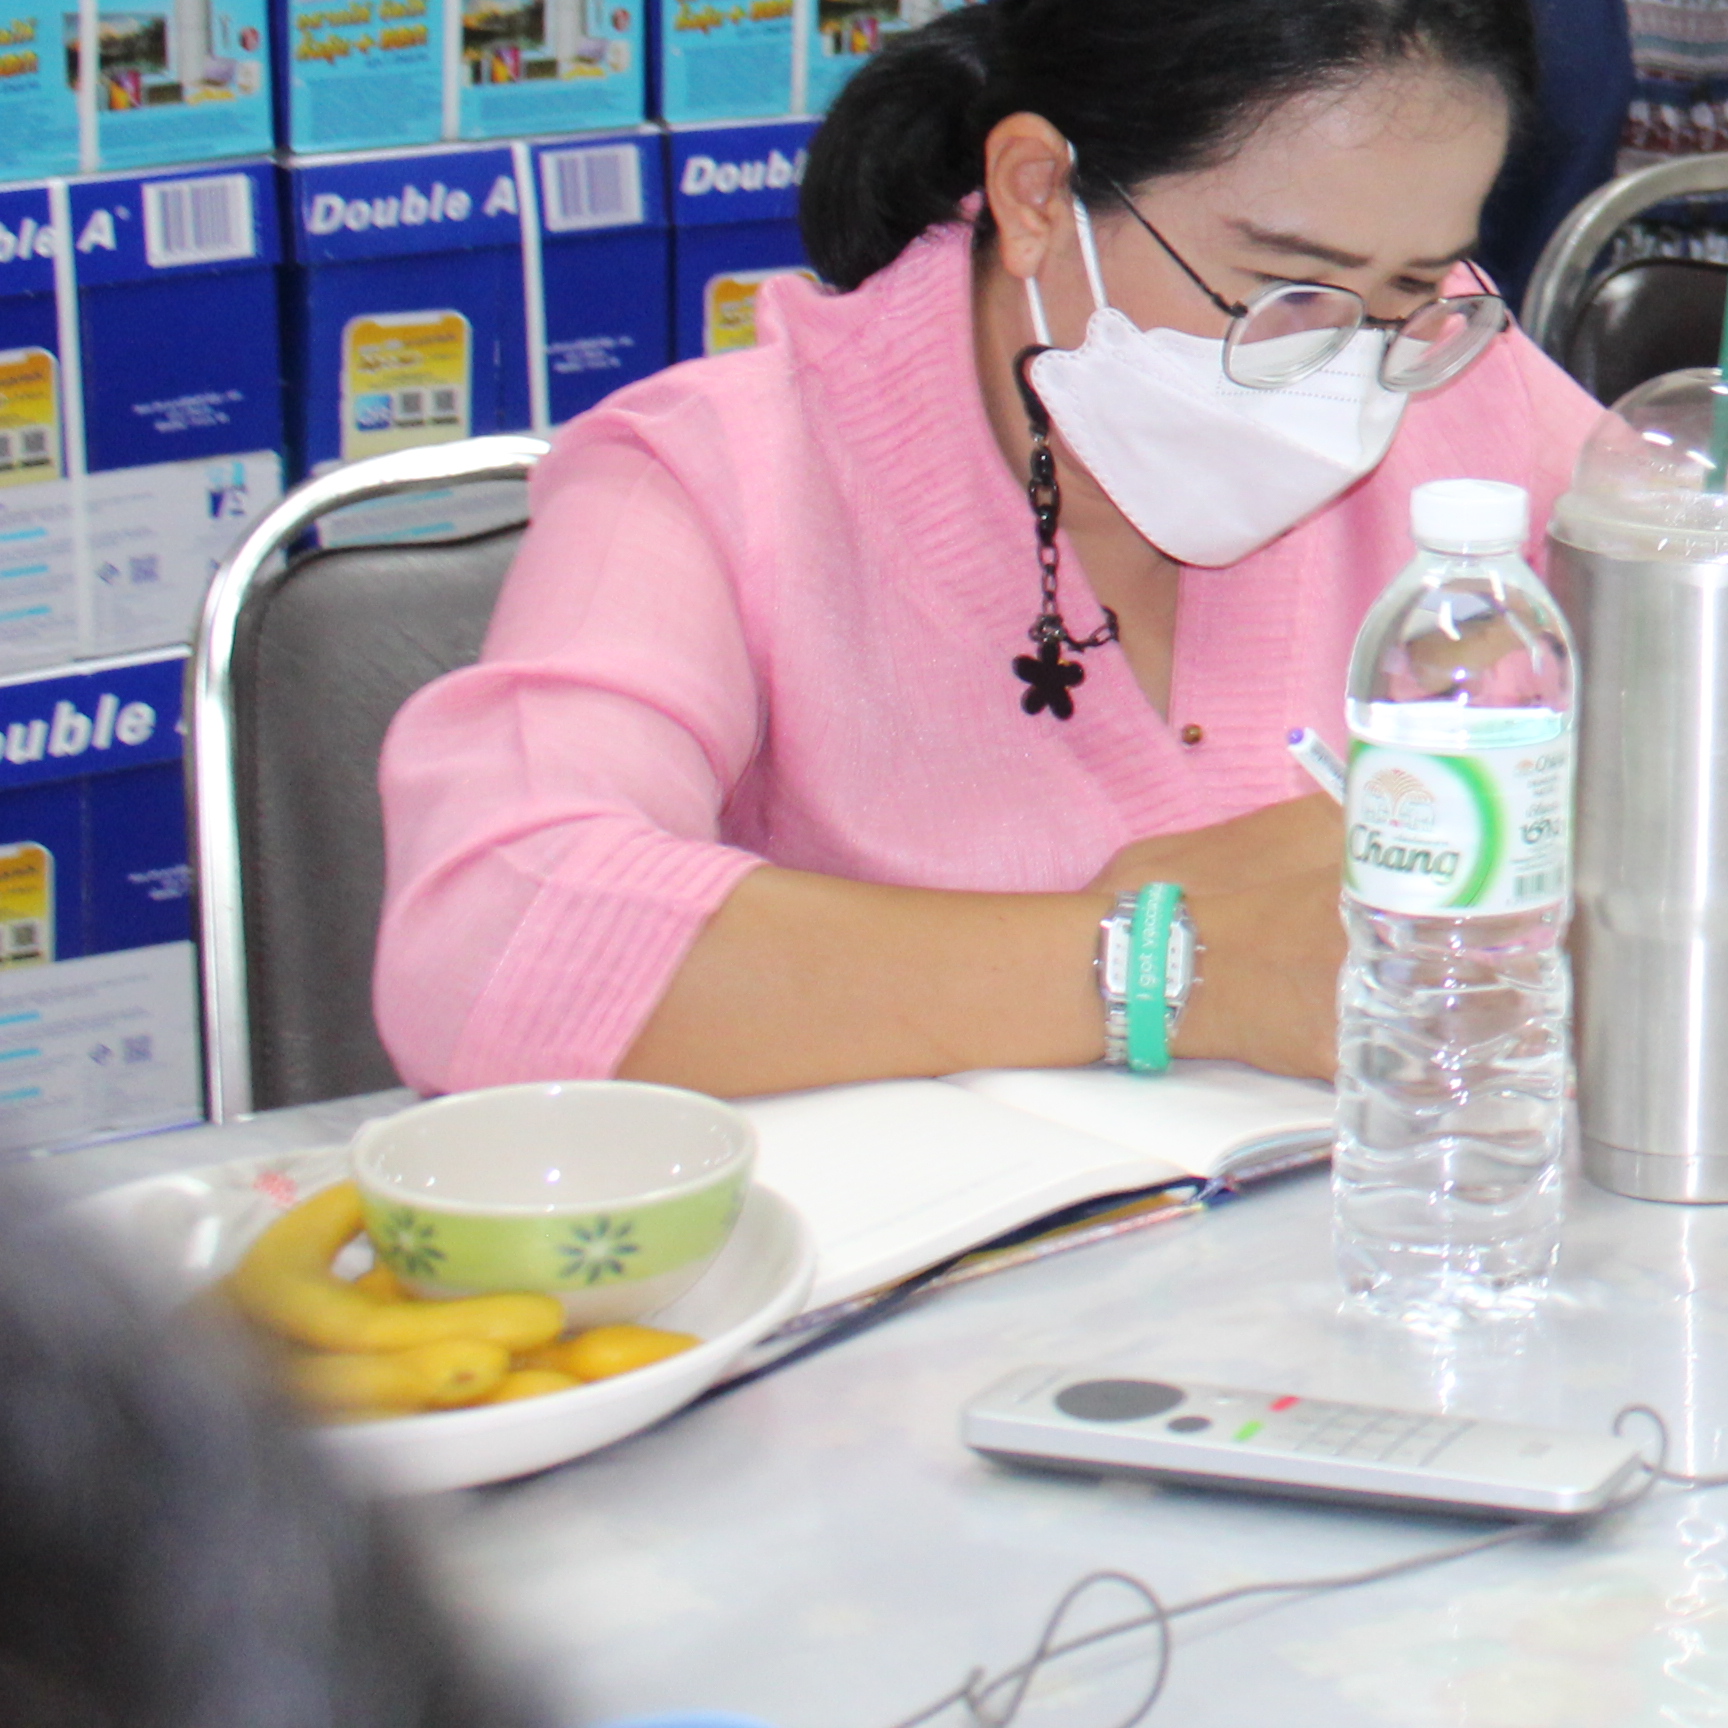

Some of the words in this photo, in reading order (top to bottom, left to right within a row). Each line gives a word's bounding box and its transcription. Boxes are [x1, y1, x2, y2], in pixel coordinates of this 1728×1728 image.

[680, 148, 808, 196] Doubl
[76, 208, 117, 254] A
[306, 181, 473, 235] Double
[483, 174, 519, 217] A
[0, 693, 156, 765] uble
[1348, 822, 1461, 886] Chang
